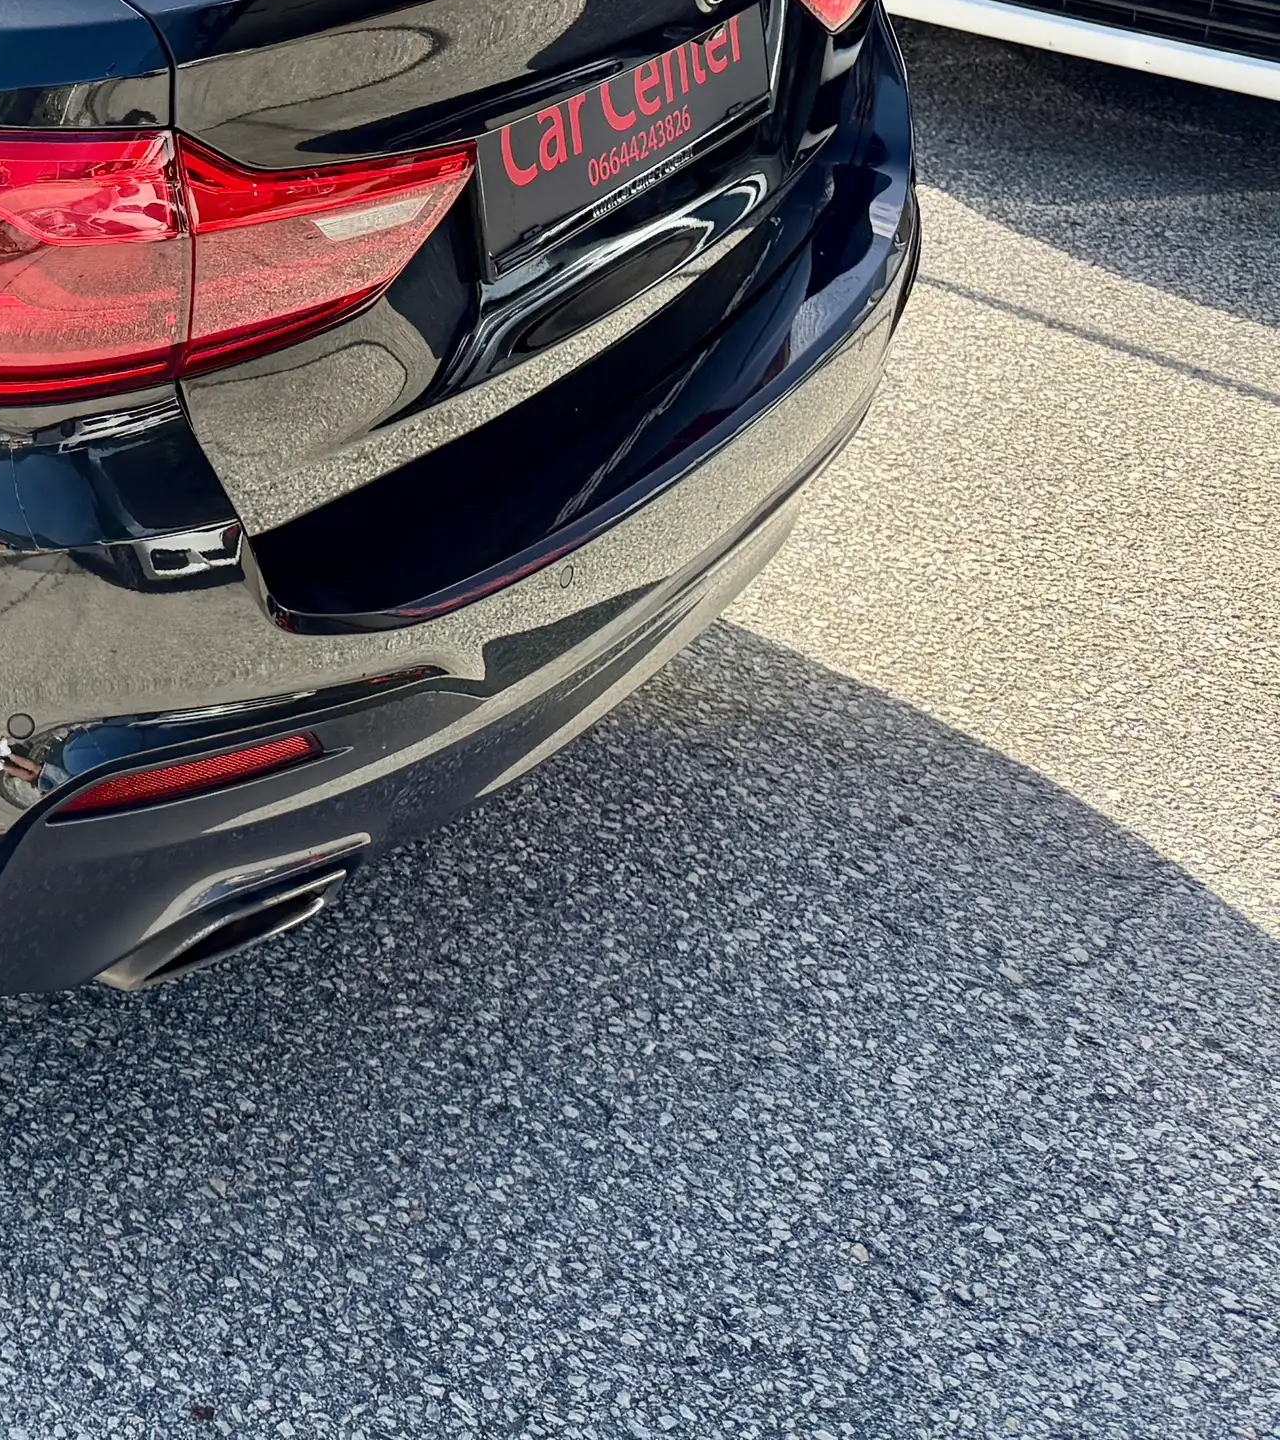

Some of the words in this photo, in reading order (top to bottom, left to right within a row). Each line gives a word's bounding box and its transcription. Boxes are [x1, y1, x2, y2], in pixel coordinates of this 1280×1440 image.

[500, 94, 587, 188] Car
[600, 15, 742, 133] Center
[588, 105, 692, 188] 06644243826
